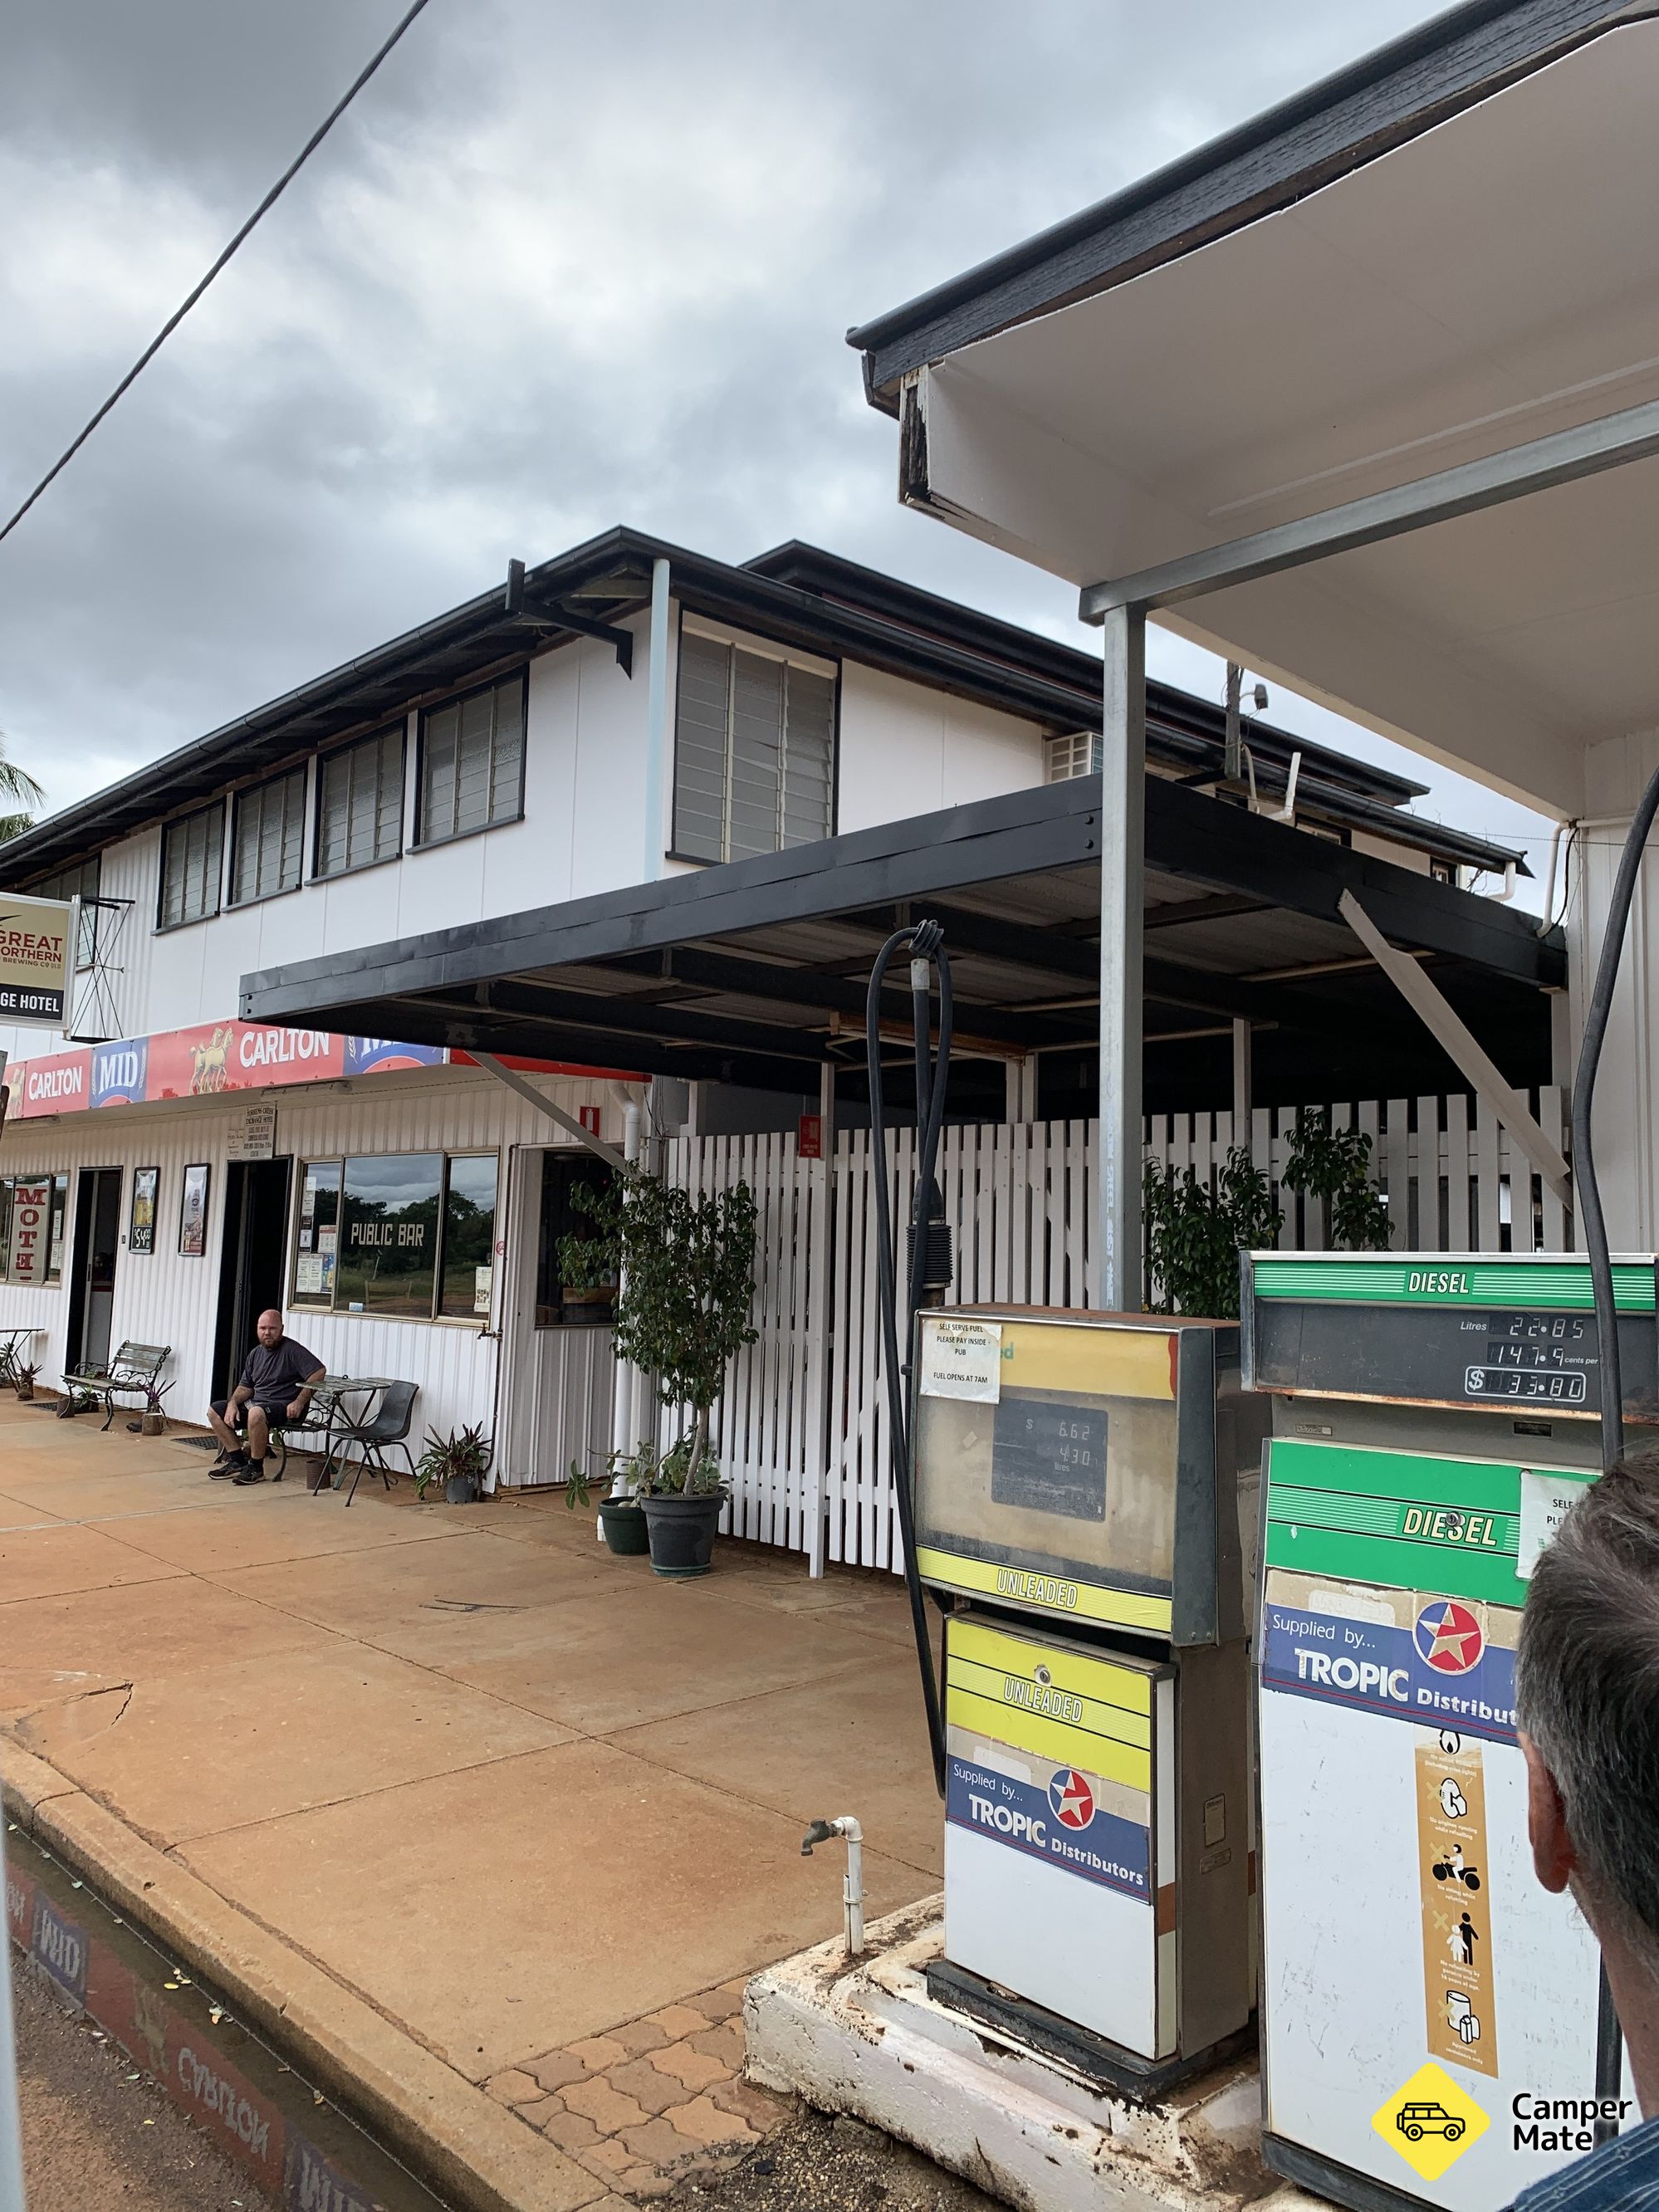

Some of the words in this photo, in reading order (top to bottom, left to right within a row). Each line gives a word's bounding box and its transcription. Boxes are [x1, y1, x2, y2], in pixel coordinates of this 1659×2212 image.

[0, 929, 63, 951] GREAT
[0, 946, 61, 963] ORTHERN
[2, 957, 38, 967] BREWING
[20, 994, 60, 1013] HOTEL
[239, 1030, 330, 1068] CARLTON
[28, 1065, 82, 1101] CARLTON
[99, 1051, 139, 1094] MID
[15, 1187, 47, 1280] MOTE
[350, 1223, 393, 1245] PUBLIC
[398, 1223, 424, 1246] BAR
[1407, 1271, 1470, 1295] DIESEL
[939, 1323, 951, 1331] SELF
[1461, 1321, 1487, 1331] Litres
[933, 1372, 946, 1380] FUEL
[947, 1373, 965, 1382] OPENS
[1468, 1369, 1485, 1390] $
[1055, 1461, 1070, 1472] litres
[1553, 1499, 1573, 1509] SELF
[1402, 1508, 1498, 1546] DIESEL
[1547, 1515, 1563, 1524] PLE
[996, 1568, 1079, 1609] UNLEADED
[1273, 1615, 1335, 1640] Supplied
[1344, 1628, 1376, 1649] by...
[1294, 1647, 1409, 1702] TROPIC
[1417, 1688, 1520, 1727] Distribut
[1003, 1677, 1084, 1723] UNLEADED
[953, 1764, 996, 1790] Supplied
[1001, 1782, 1023, 1802] by...
[968, 1794, 1046, 1847] TROPIC
[1051, 1838, 1143, 1886] Distributors
